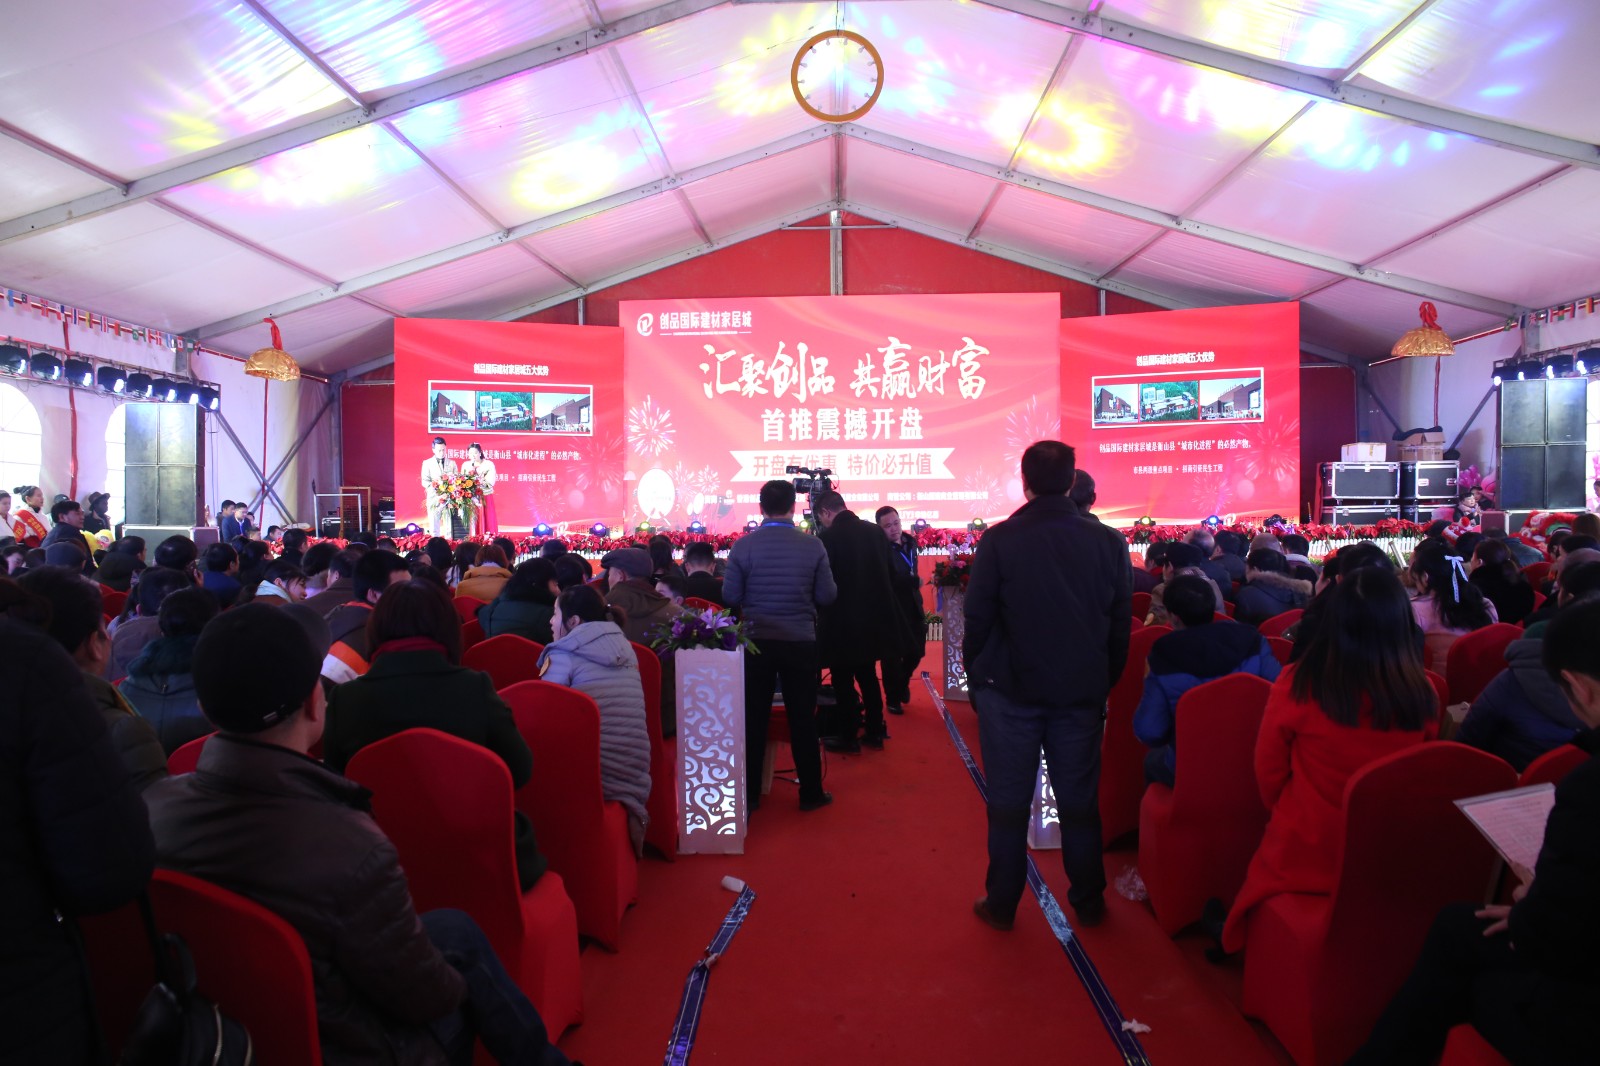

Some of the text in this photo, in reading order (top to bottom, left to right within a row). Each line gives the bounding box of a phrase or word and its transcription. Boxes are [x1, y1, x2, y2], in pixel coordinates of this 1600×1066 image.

[660, 311, 752, 330] 创品国际建材家居城
[699, 336, 991, 403] 汇聚创品 共赢财富
[761, 406, 924, 442] 首推震撼开盘
[847, 452, 933, 476] 特价必升值
